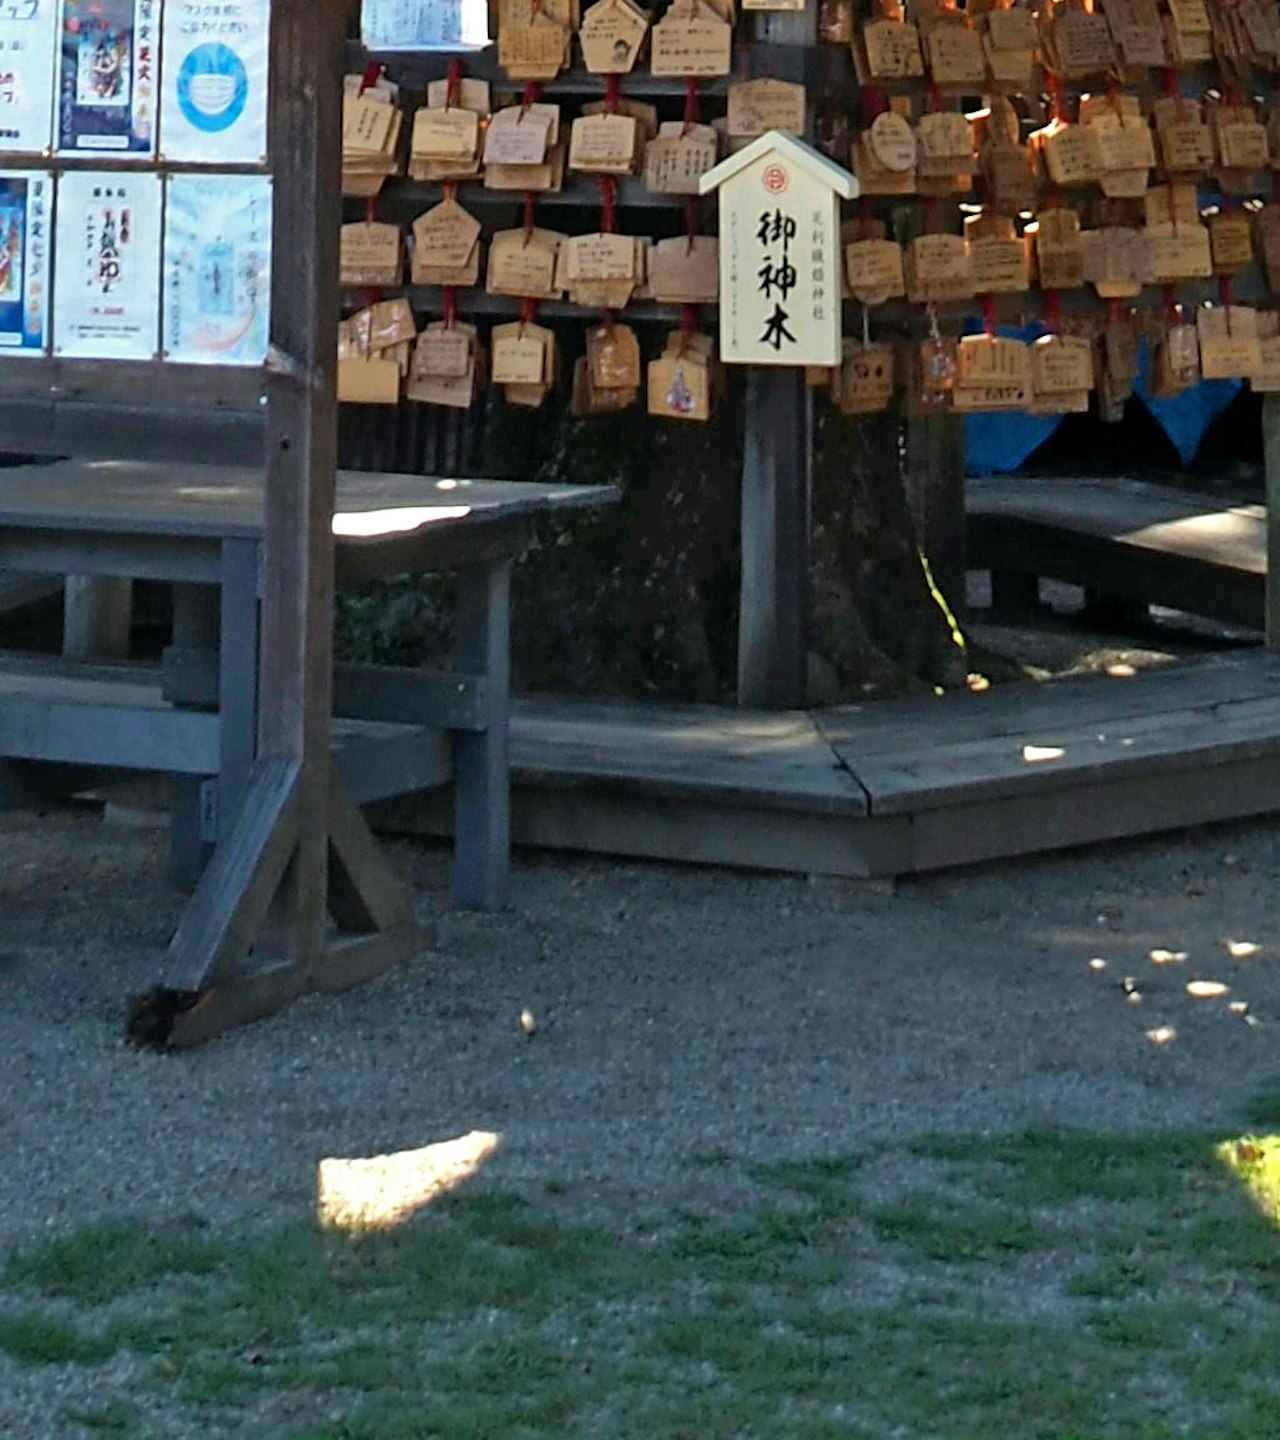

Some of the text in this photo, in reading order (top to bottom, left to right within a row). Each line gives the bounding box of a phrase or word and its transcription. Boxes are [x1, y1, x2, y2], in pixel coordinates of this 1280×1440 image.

[755, 207, 798, 351] 御神木
[811, 210, 825, 321] 足利織姫神社
